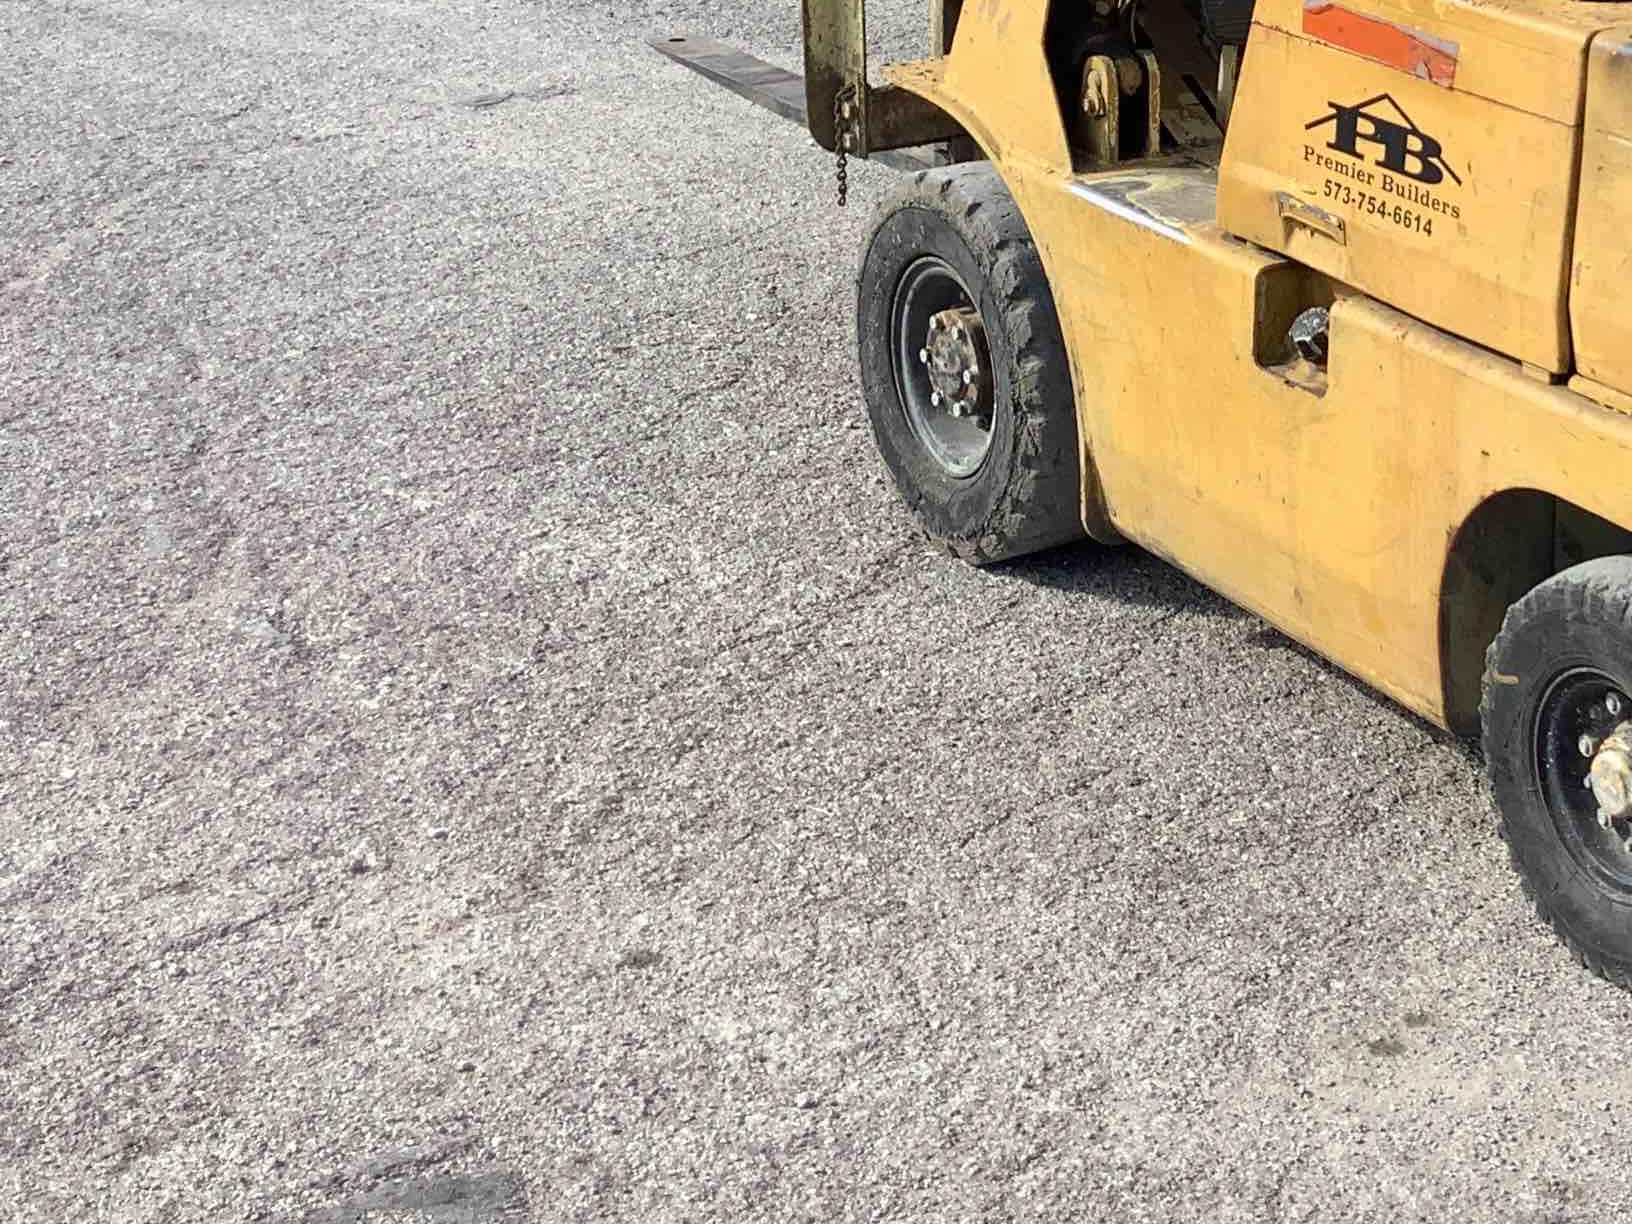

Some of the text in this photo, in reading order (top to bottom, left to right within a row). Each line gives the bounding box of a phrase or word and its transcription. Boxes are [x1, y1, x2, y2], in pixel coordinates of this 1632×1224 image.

[1326, 101, 1443, 185] PB
[1303, 144, 1461, 219] Premier Builders
[1323, 178, 1433, 237] 573-754-6614
